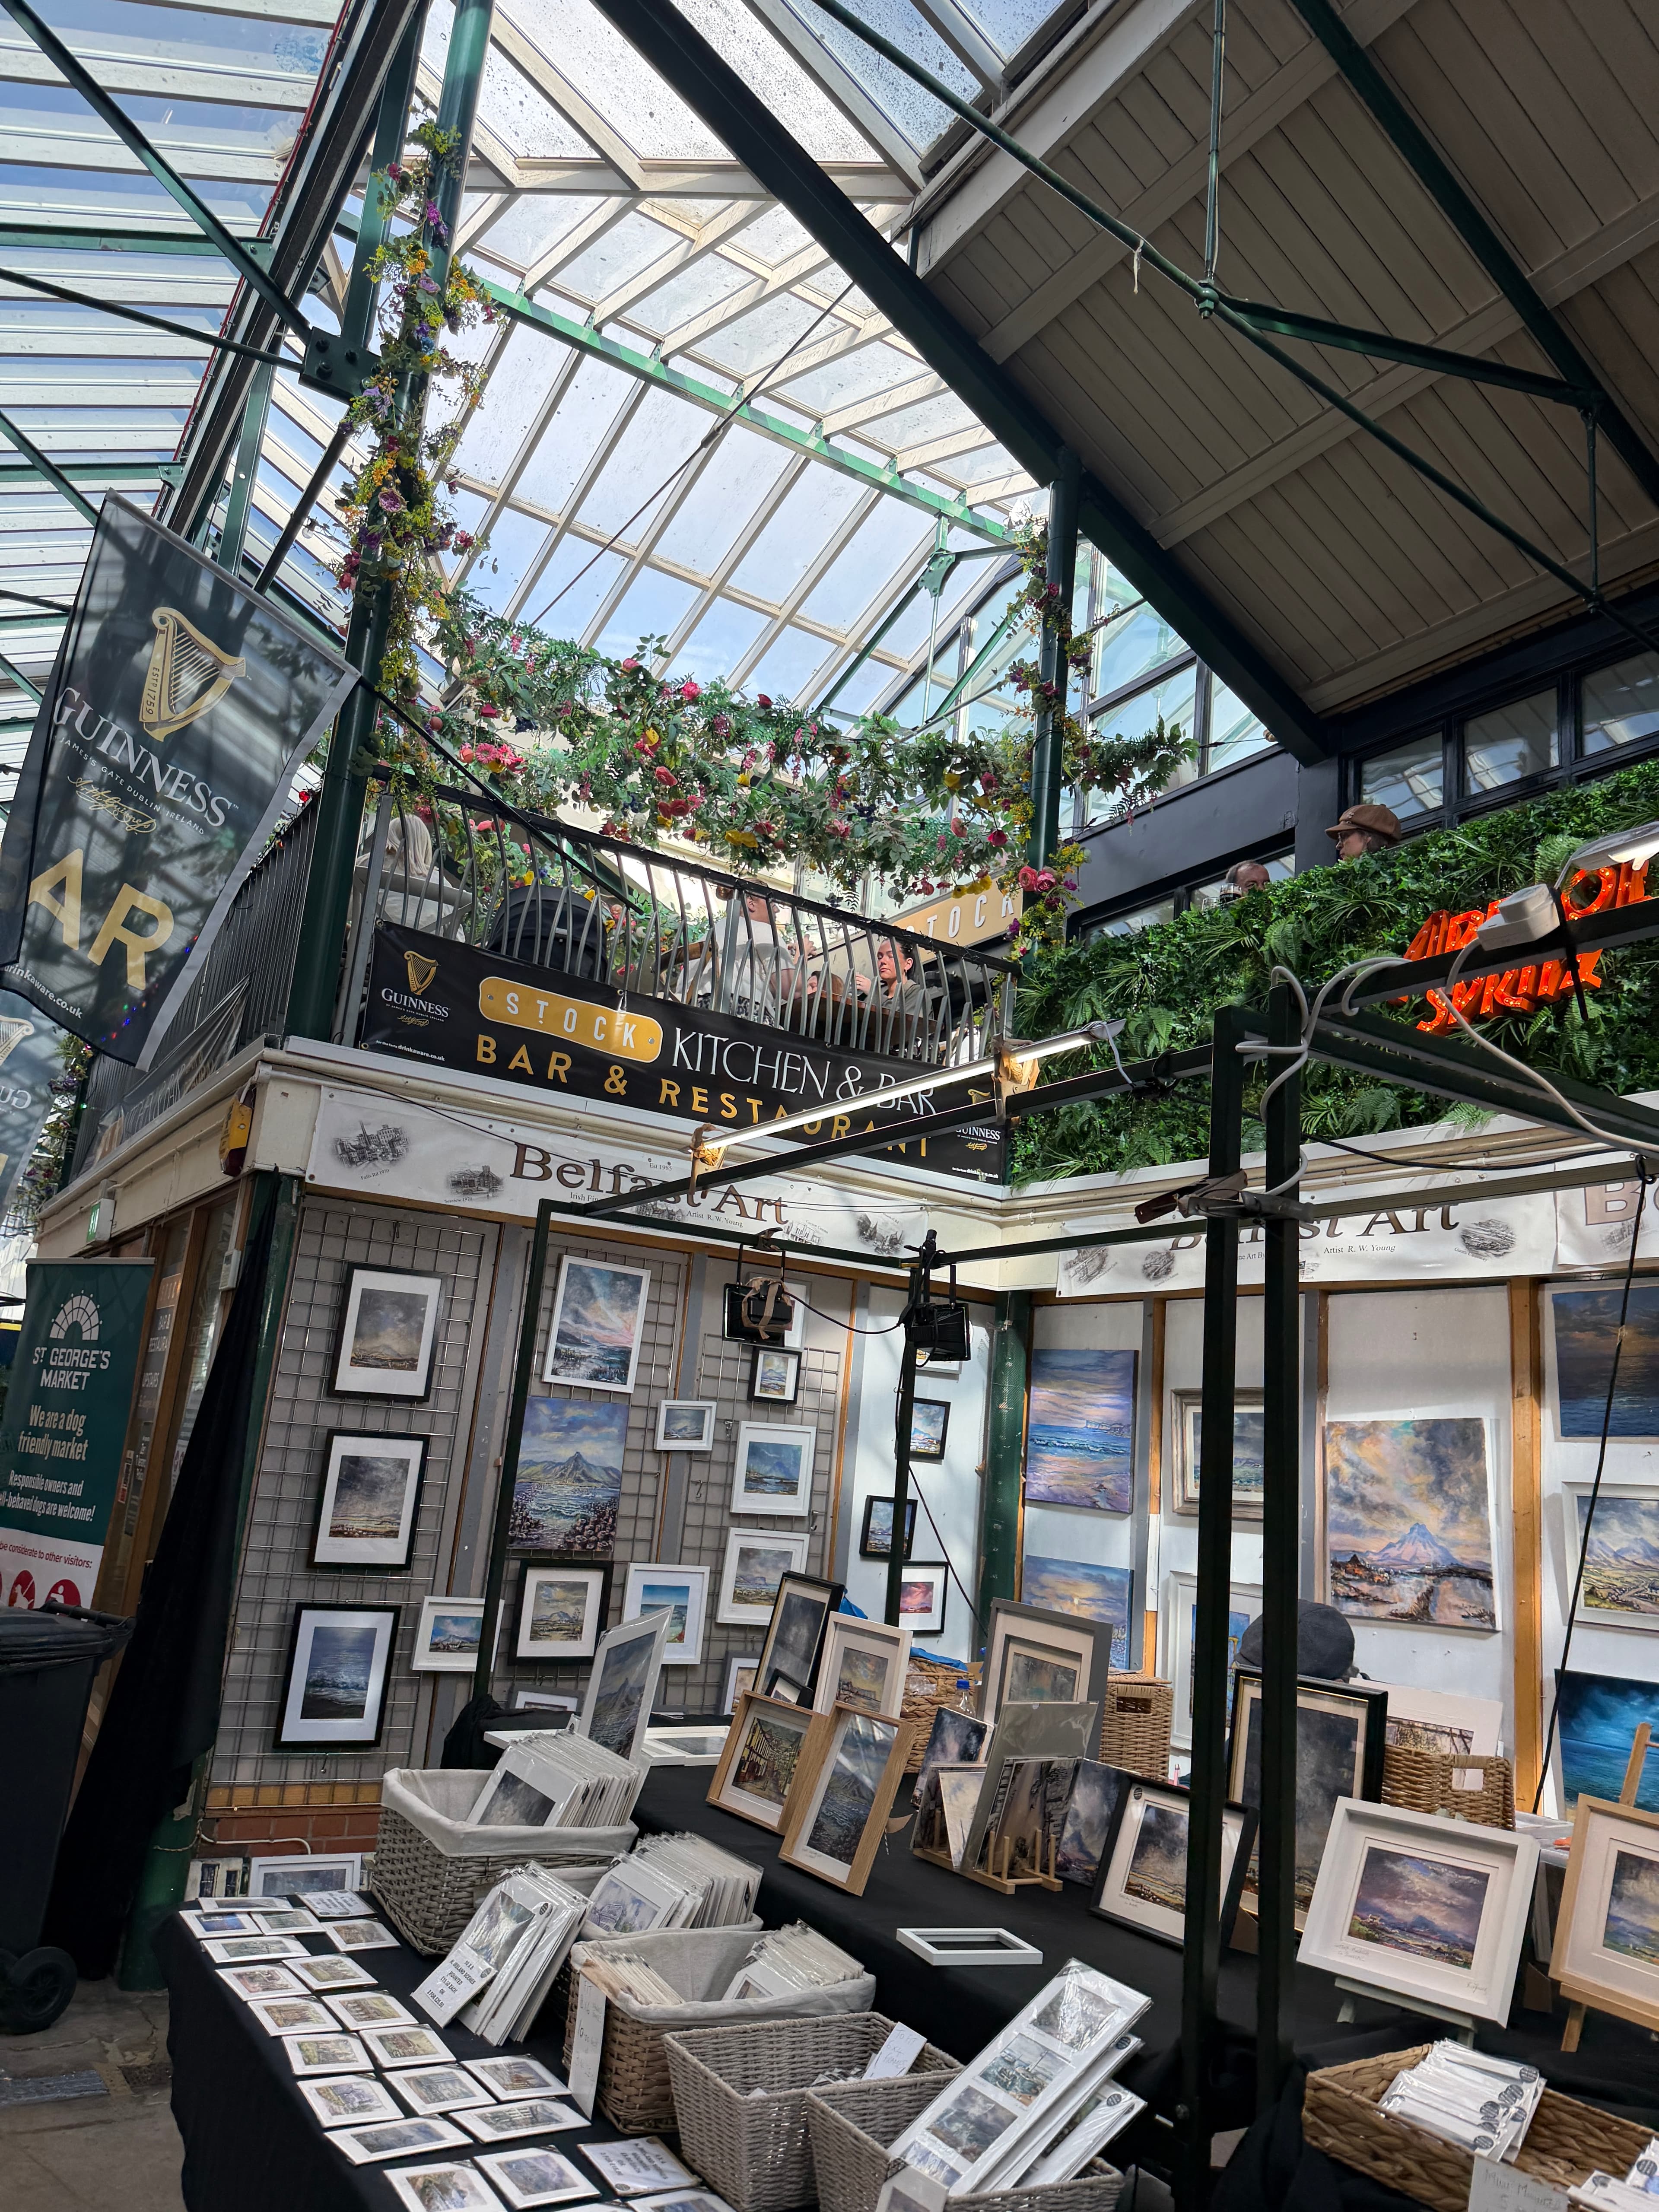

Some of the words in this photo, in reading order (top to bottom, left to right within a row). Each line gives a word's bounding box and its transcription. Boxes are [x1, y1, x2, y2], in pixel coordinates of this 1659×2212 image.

[145, 690, 156, 715] 1759
[52, 687, 232, 827] GUINNESS
[102, 766, 124, 785] GATE
[127, 785, 160, 812] DUBLIN
[166, 811, 204, 835] IRELAND
[906, 893, 1014, 938] TOCK
[381, 988, 449, 1018] GUINNESS
[398, 1044, 445, 1062] drinkaware.co.uk
[477, 1034, 572, 1084] BAR
[604, 1065, 628, 1096] &
[506, 992, 637, 1049] STOCK
[672, 1027, 831, 1100] KITCHEN
[836, 1065, 864, 1101] &
[877, 1073, 937, 1116] BAR
[570, 1192, 586, 1201] Irish
[711, 1185, 789, 1225] Art
[686, 1210, 704, 1219] Artist
[725, 1217, 744, 1228] Young
[49, 1347, 111, 1370] GEORGE'S
[40, 1369, 90, 1390] MARKET
[29, 1405, 45, 1427] We
[46, 1411, 58, 1428] are
[59, 1415, 65, 1430] a
[67, 1408, 86, 1437] dog
[17, 1431, 50, 1460] friendly
[52, 1437, 89, 1461] market
[9, 1470, 44, 1490] Responsible
[44, 1479, 68, 1494] owners
[67, 1480, 84, 1497] and
[32, 1495, 46, 1516] dogs
[46, 1503, 57, 1516] are
[57, 1501, 96, 1522] welcome!
[9, 1544, 38, 1558] considerate
[38, 1550, 44, 1559] to
[45, 1552, 63, 1563] other
[64, 1554, 93, 1569] visitors:
[448, 1970, 463, 1985] MOUNTED
[453, 1962, 466, 1974] IRELAND
